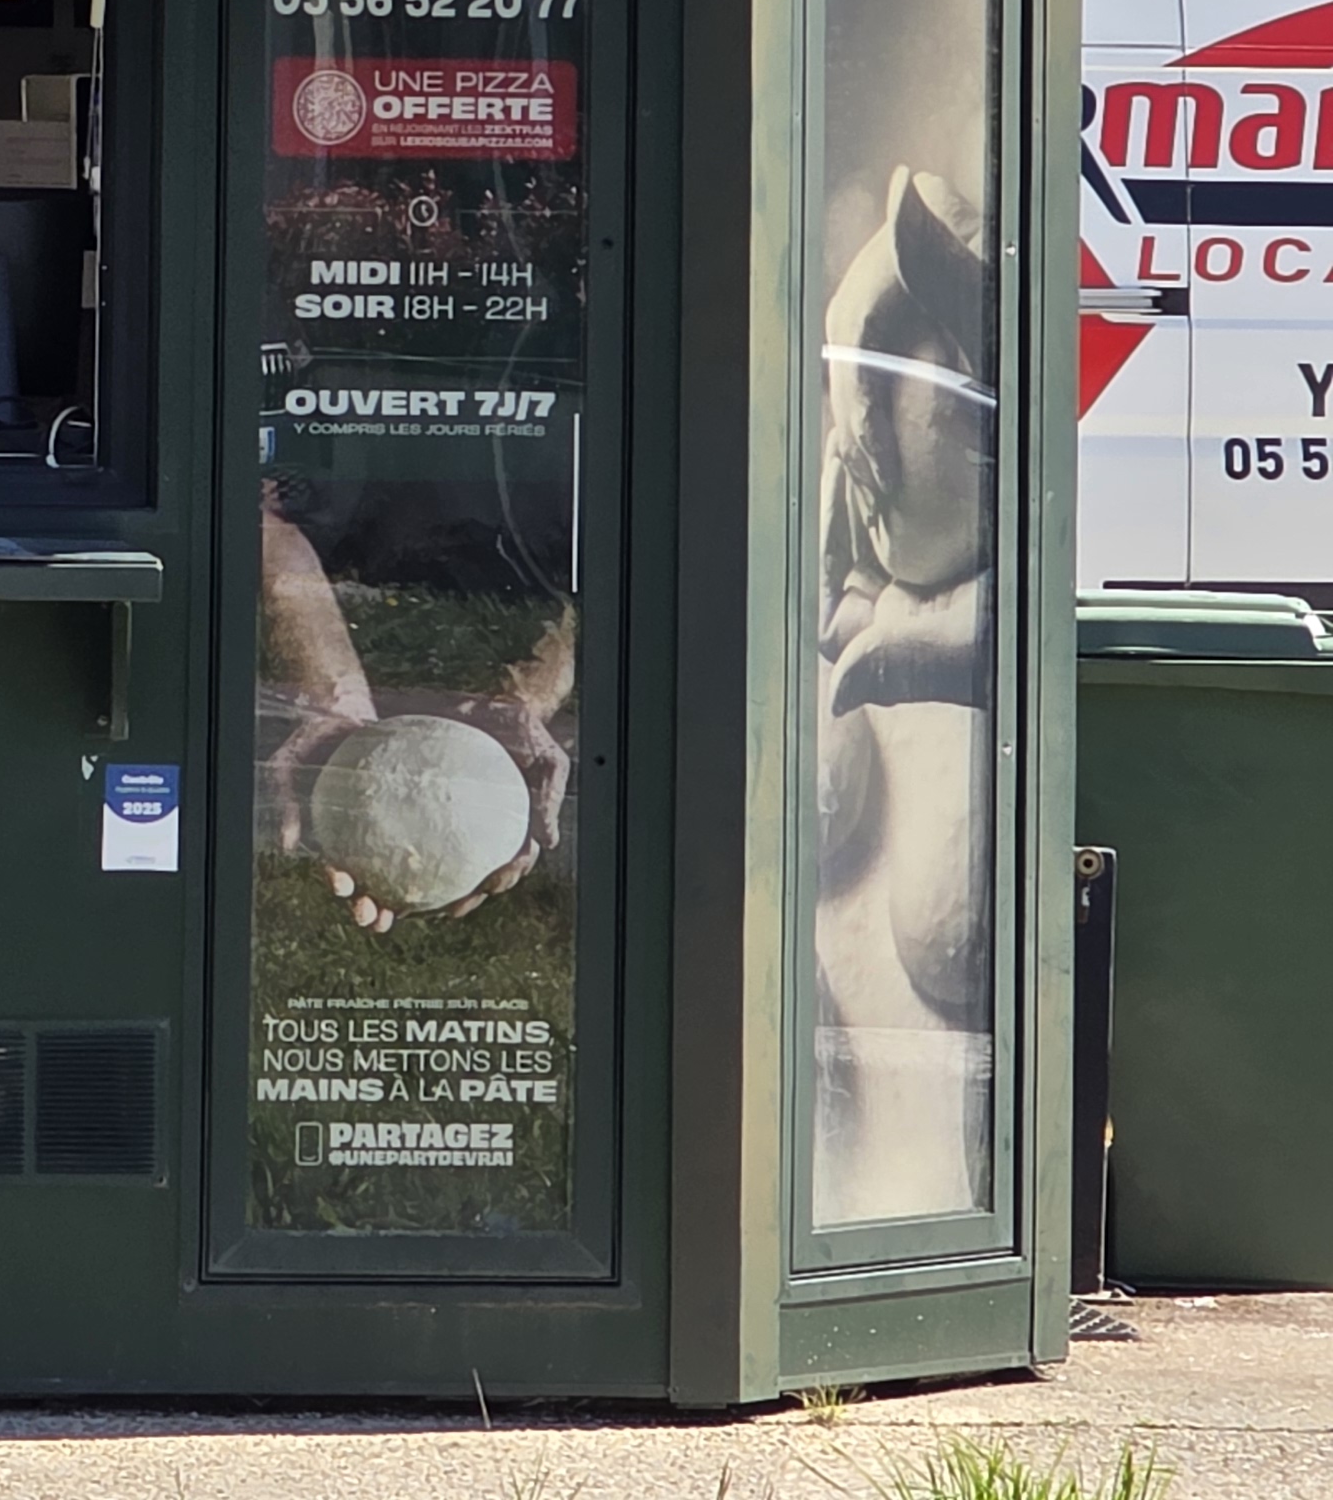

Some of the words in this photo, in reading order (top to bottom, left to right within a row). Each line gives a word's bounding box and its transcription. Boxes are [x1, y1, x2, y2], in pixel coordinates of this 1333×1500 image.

[374, 70, 443, 92] UNE
[455, 71, 554, 94] PIZZA
[373, 96, 553, 121] OFFERTE
[311, 260, 401, 285] MIDI
[409, 262, 448, 285] 11H
[482, 262, 532, 286] 14H
[295, 294, 395, 319] SOIR
[404, 295, 454, 320] 18H
[485, 296, 547, 321] 22H
[286, 389, 465, 416] OUVERT
[474, 391, 556, 421] 7J/7
[294, 422, 305, 434] Y
[309, 423, 385, 435] COMPRIS
[390, 424, 421, 436] LES
[425, 424, 480, 436] JOURS
[485, 420, 545, 437] FÉRIÉS
[1224, 437, 1284, 481] 05
[122, 802, 162, 815] 2025
[263, 1018, 339, 1042] TOUS
[348, 1019, 398, 1043] LES
[405, 1020, 554, 1046] MATINS,
[263, 1049, 343, 1071] NOUS
[353, 1049, 490, 1072] METTONS
[501, 1050, 552, 1073] LES
[257, 1078, 384, 1101] MAINS
[389, 1073, 409, 1101] À
[419, 1079, 454, 1101] LA
[459, 1074, 557, 1102] PÂTE
[329, 1123, 513, 1149] PARTAGEZ
